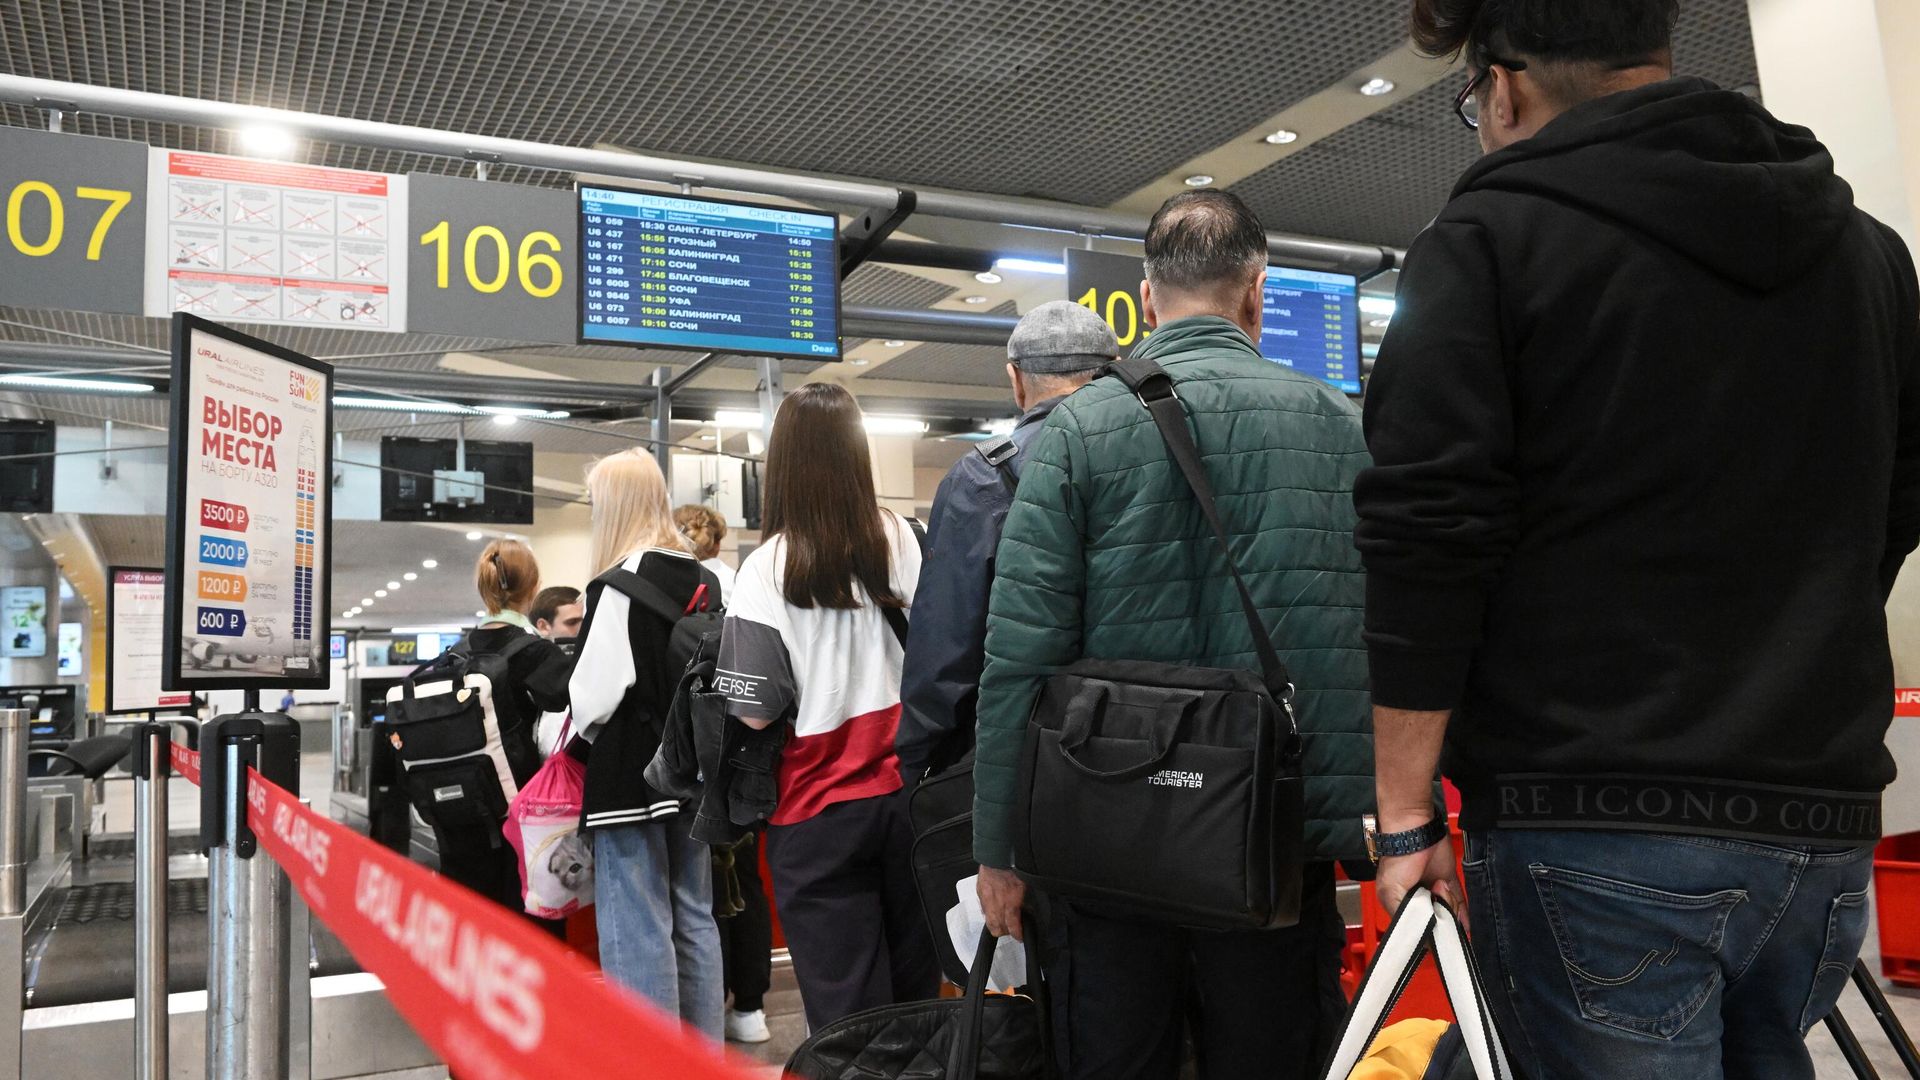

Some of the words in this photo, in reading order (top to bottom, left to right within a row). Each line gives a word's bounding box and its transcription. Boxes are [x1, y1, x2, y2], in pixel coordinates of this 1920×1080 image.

[586, 191, 614, 201] 14:40
[641, 196, 729, 214] РЕГИСТРАЦИЯ
[7, 180, 132, 261] 07
[588, 216, 601, 224] U6
[668, 224, 758, 240] САНКТ-ПЕТЕРБУРГ
[788, 237, 812, 246] 14:50
[588, 228, 601, 236] U6
[605, 230, 623, 238] 437
[668, 236, 717, 248] ГРОЗНЫЙ
[420, 221, 563, 298] 106
[588, 240, 601, 248] U6
[606, 242, 623, 250] 167
[668, 248, 740, 263] КАЛИНИНГРАД
[588, 253, 601, 261] U6
[606, 254, 623, 263] 471
[641, 258, 666, 267] 17:10
[668, 260, 697, 270] СОЧИ
[588, 265, 602, 273] U6
[641, 270, 666, 279] 17:45
[668, 273, 750, 287] БЛАГОВЕЩЕНСК
[588, 277, 602, 285] U6
[606, 279, 630, 288] 6005
[668, 284, 697, 294] СОЧИ
[588, 290, 602, 298] U6
[641, 294, 666, 303] 18:30
[669, 297, 691, 306] УФА
[588, 302, 602, 310] U6
[607, 304, 624, 312] 073
[641, 307, 666, 315] 19:00
[669, 309, 741, 323] КАЛИНИНГРАД
[1078, 287, 1151, 346] 10
[589, 315, 602, 323] U6
[607, 317, 630, 325] 6057
[641, 319, 666, 328] 19:10
[669, 321, 698, 331] СОЧИ
[811, 344, 834, 353] Dear
[289, 370, 305, 386] FUN
[289, 384, 305, 399] SUN
[203, 395, 283, 441] ВЫБОР
[202, 428, 277, 472] МЕСТА
[201, 460, 216, 474] НА
[219, 463, 253, 482] БОРТУ
[204, 503, 234, 523] 3500
[237, 509, 245, 524] ₽
[202, 541, 234, 560] 2000
[237, 546, 245, 561] ₽
[201, 577, 229, 594] 1200
[233, 580, 241, 595] ₽
[200, 612, 224, 629] 600
[230, 614, 239, 629] ₽
[394, 641, 416, 654] 127
[711, 675, 758, 697] VERSE
[1147, 776, 1203, 789] TOURISTER
[1153, 770, 1203, 781] MERICAN
[1500, 785, 1552, 815] RE
[1575, 784, 1758, 825] ICONO
